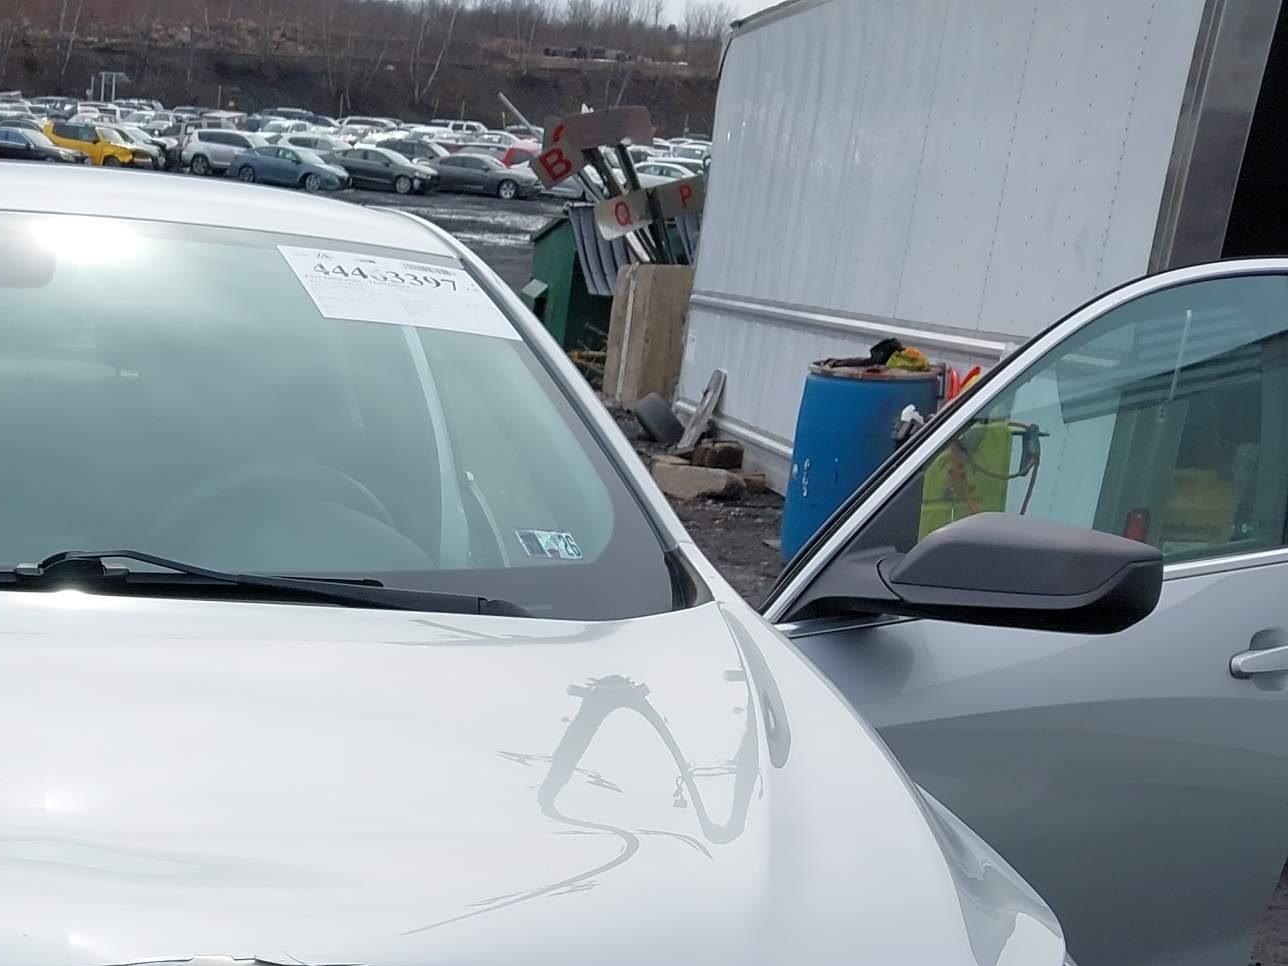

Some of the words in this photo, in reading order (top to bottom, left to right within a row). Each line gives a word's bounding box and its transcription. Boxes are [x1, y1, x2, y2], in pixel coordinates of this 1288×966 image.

[538, 147, 573, 182] B
[678, 183, 693, 208] P
[614, 201, 633, 226] Q
